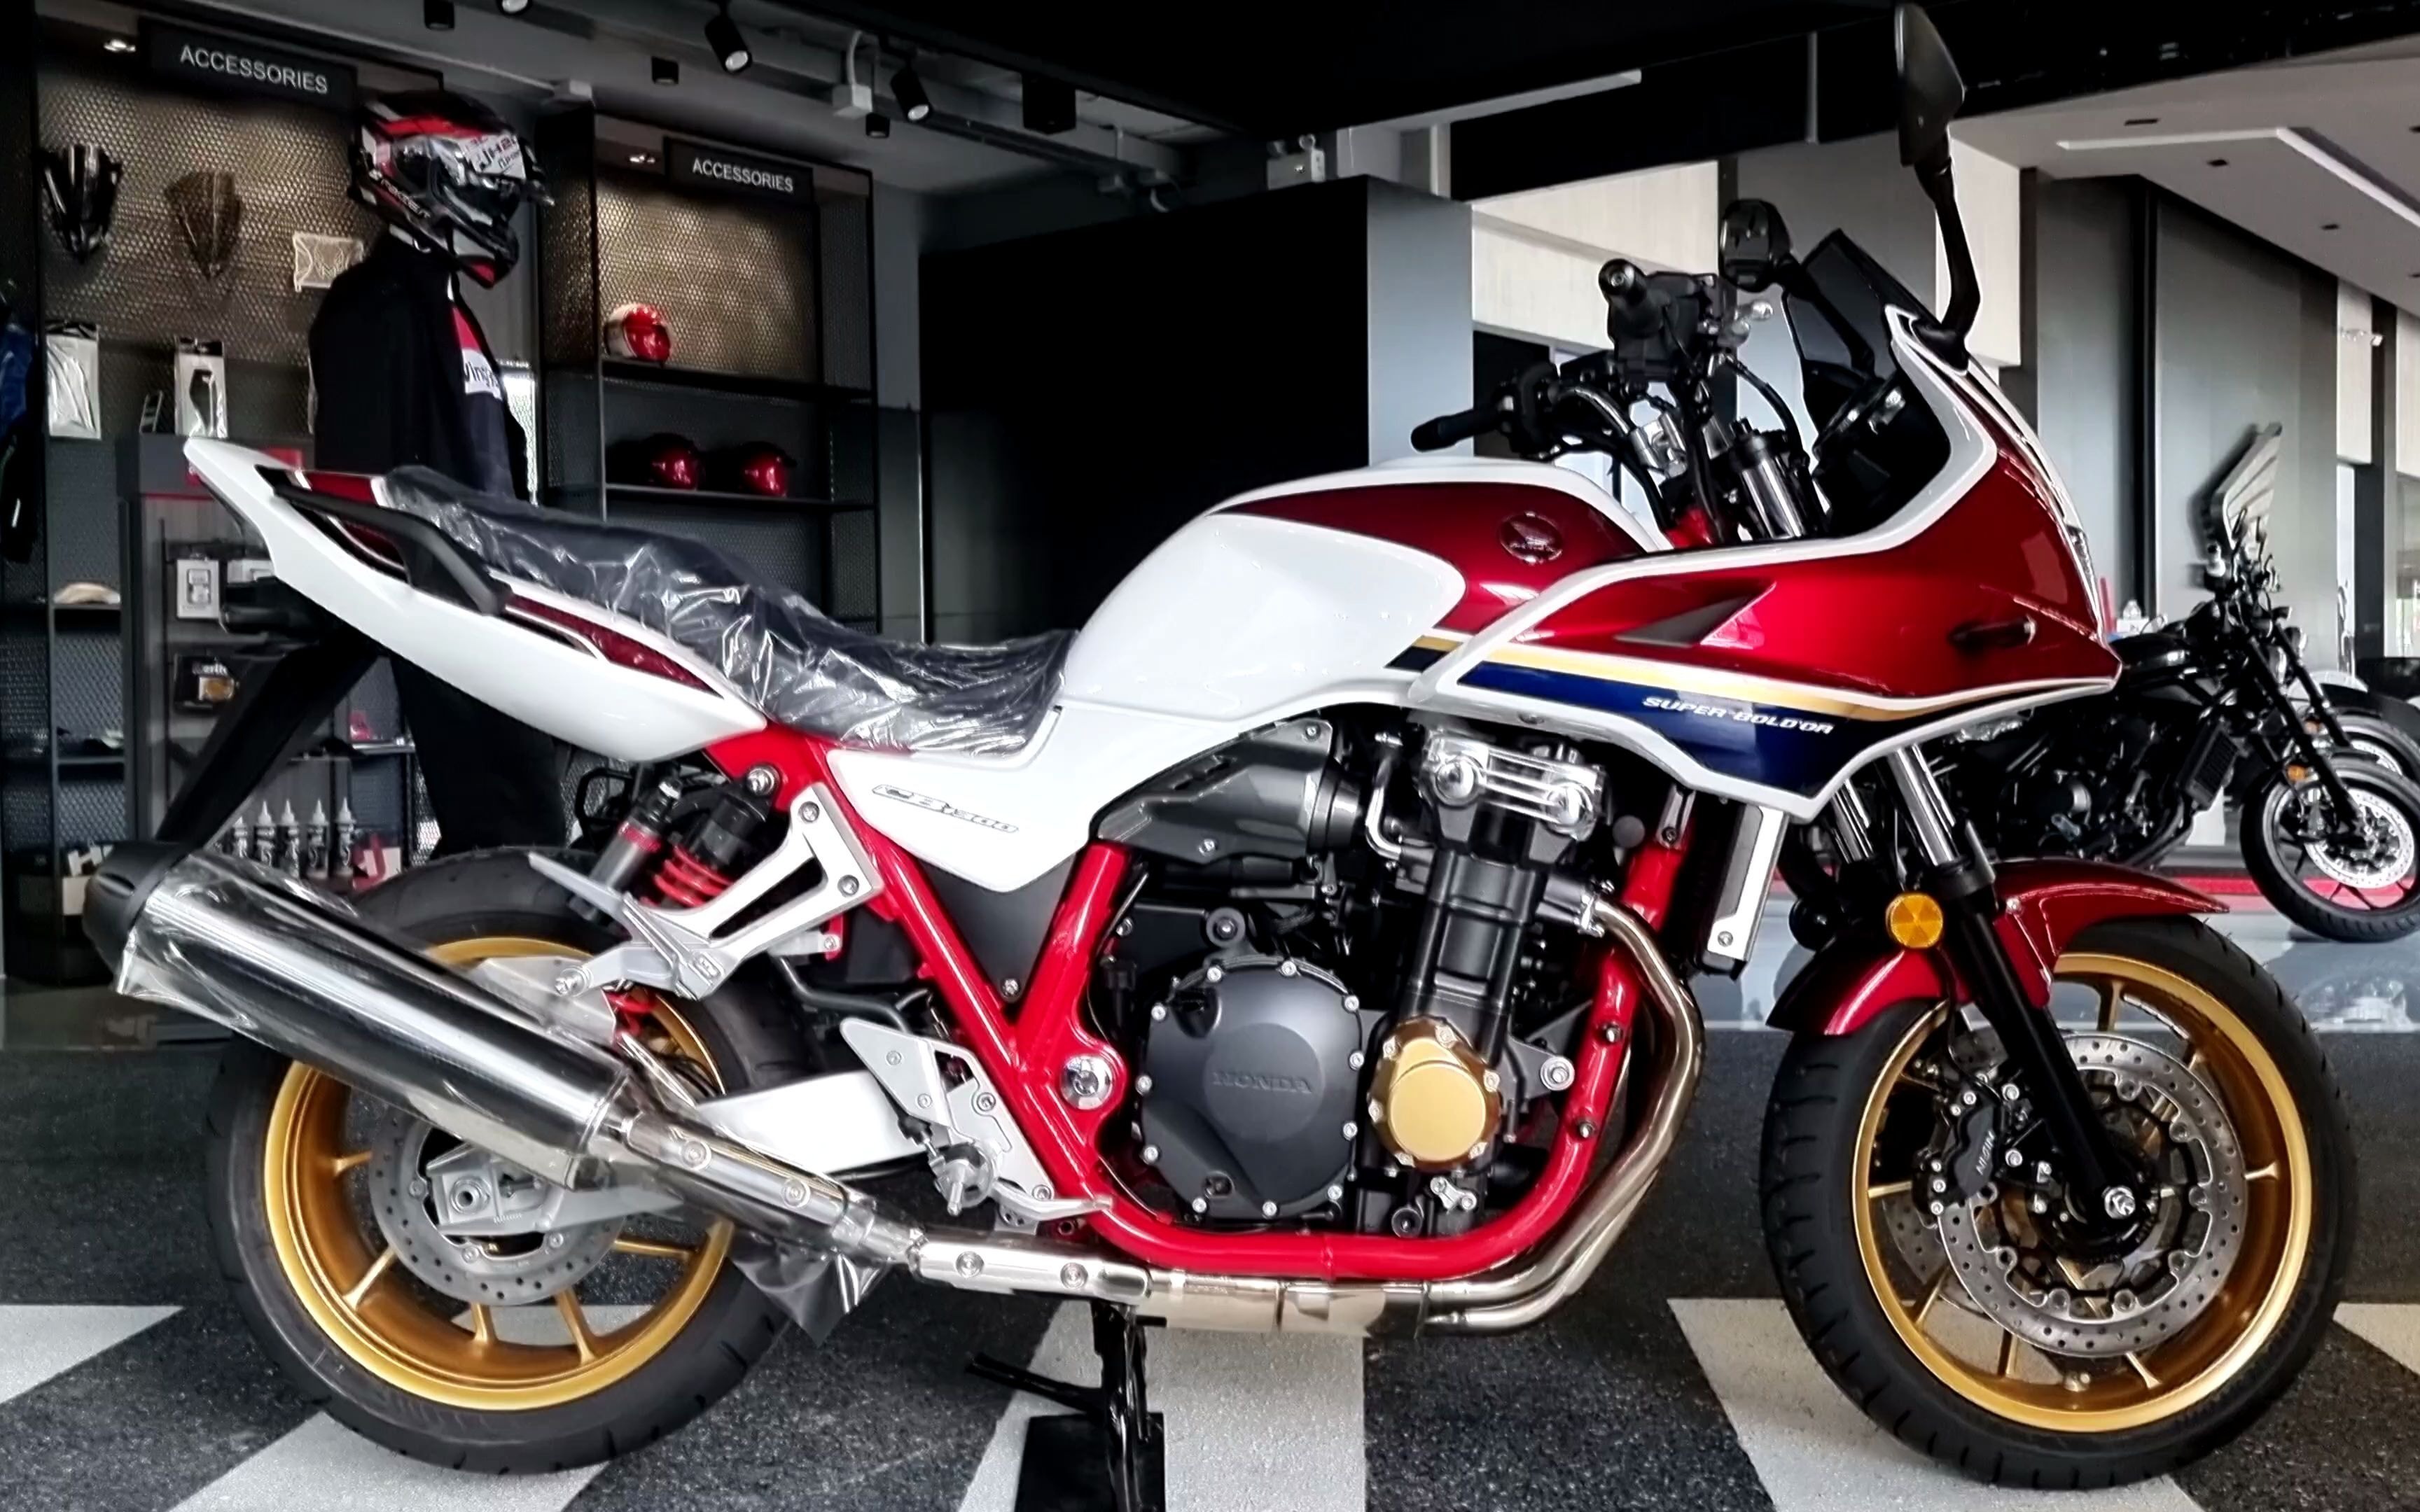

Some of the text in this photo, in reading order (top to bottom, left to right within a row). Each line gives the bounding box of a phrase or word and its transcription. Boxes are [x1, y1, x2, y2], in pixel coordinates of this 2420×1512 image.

[179, 44, 328, 94] ACCESSORIES
[692, 157, 794, 193] ACCESSORIES
[1642, 696, 1727, 718] SUPER
[1212, 1070, 1312, 1094] HONDA
